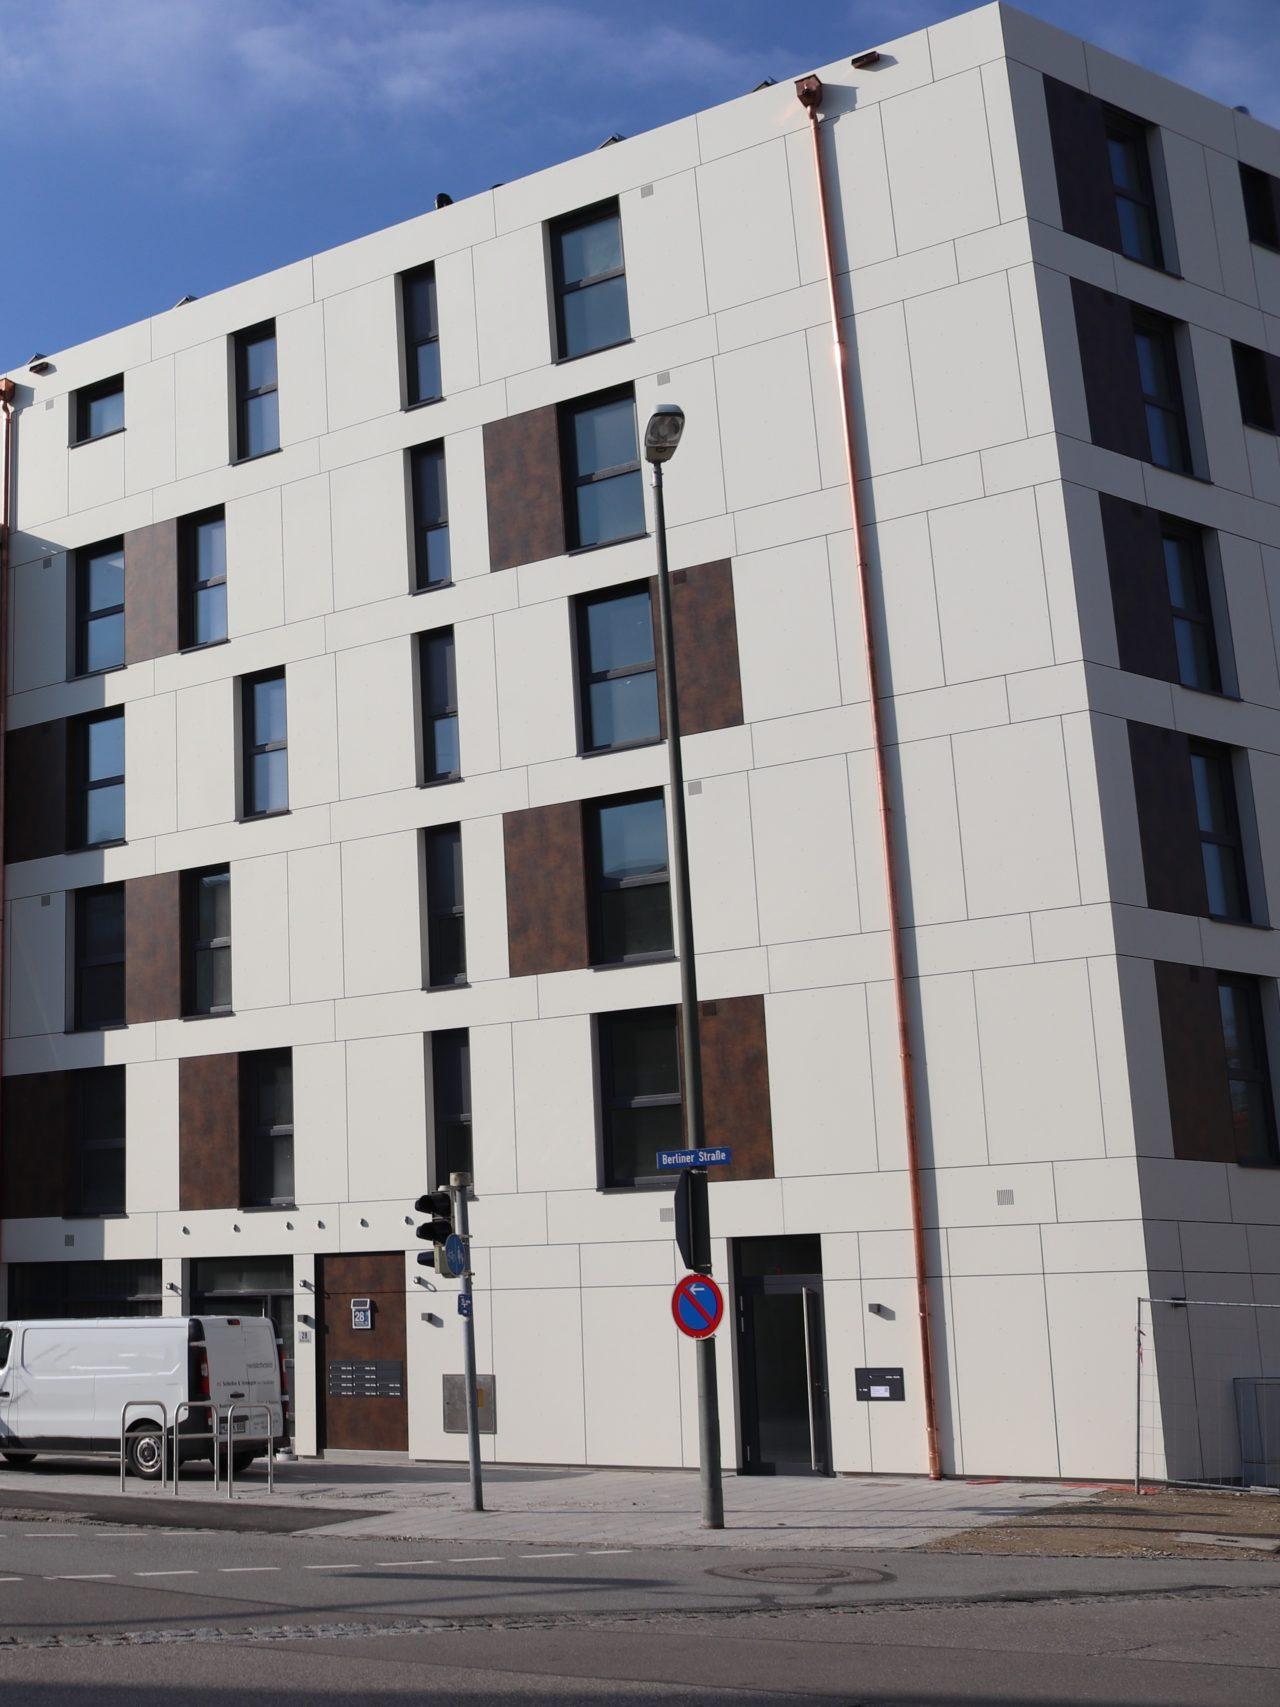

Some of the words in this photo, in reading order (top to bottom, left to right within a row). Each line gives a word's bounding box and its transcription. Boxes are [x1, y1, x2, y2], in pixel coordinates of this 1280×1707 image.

[662, 1153, 695, 1165] Berliner
[698, 1150, 726, 1162] Straße
[354, 1311, 365, 1322] 28
